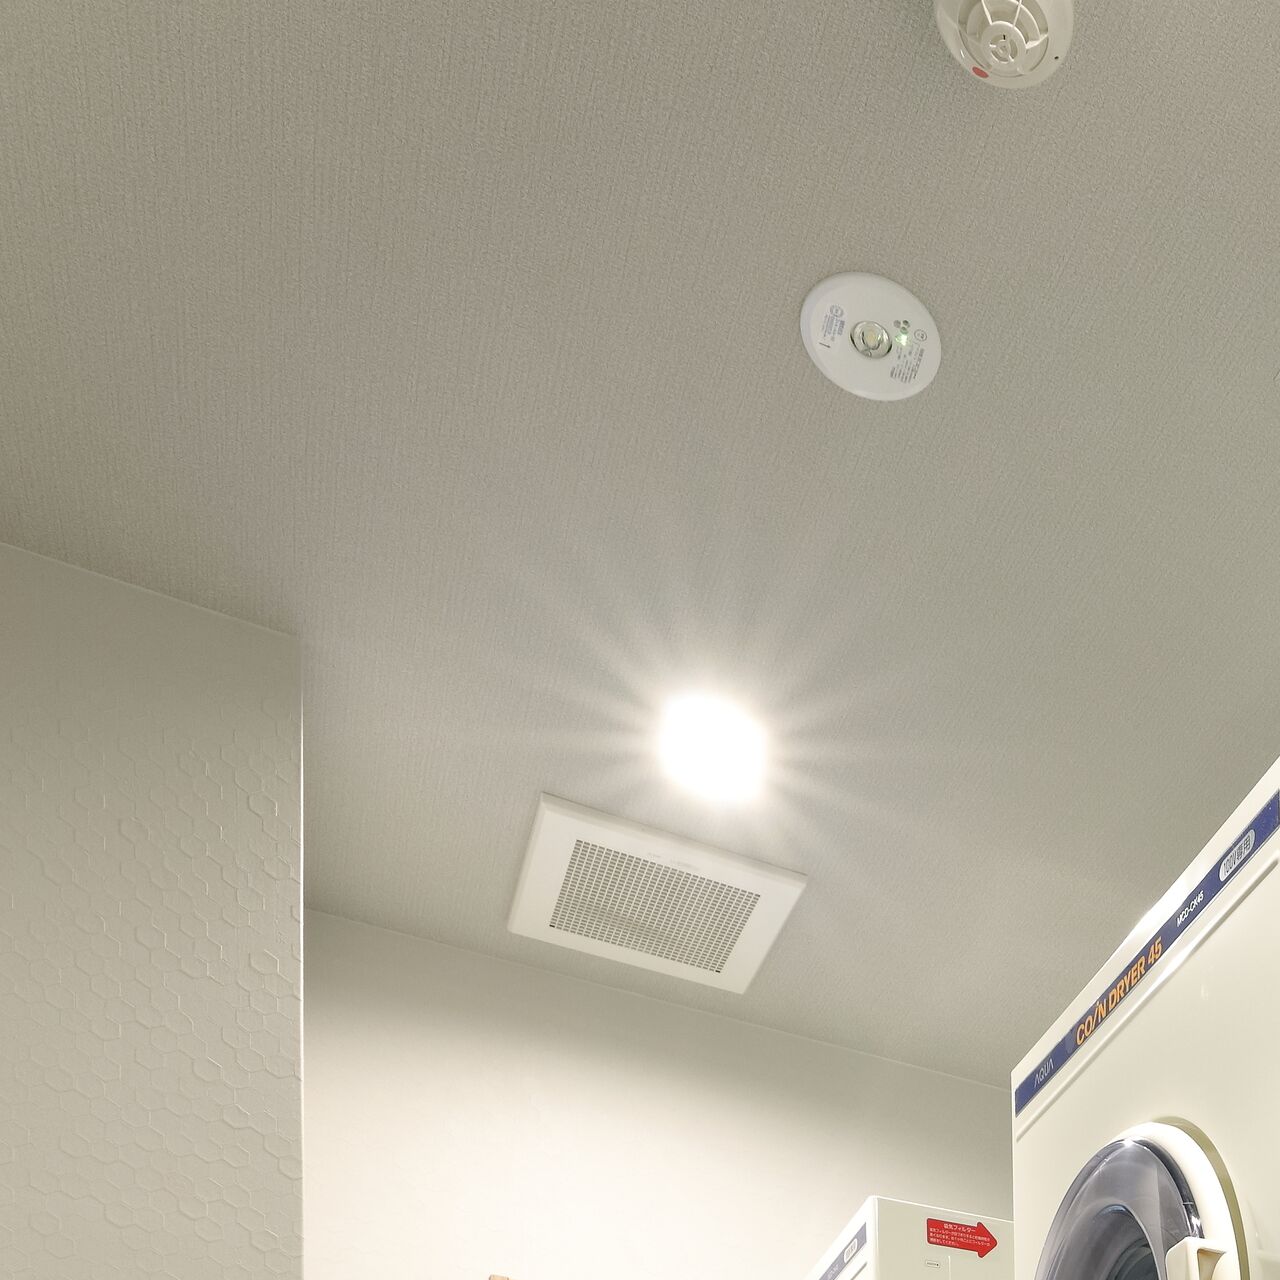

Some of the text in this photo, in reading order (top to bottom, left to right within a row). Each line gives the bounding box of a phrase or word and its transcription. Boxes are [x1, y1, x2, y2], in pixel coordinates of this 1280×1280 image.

[1076, 936, 1162, 1045] COIN DRYER 45
[1034, 1058, 1054, 1088] AQUA
